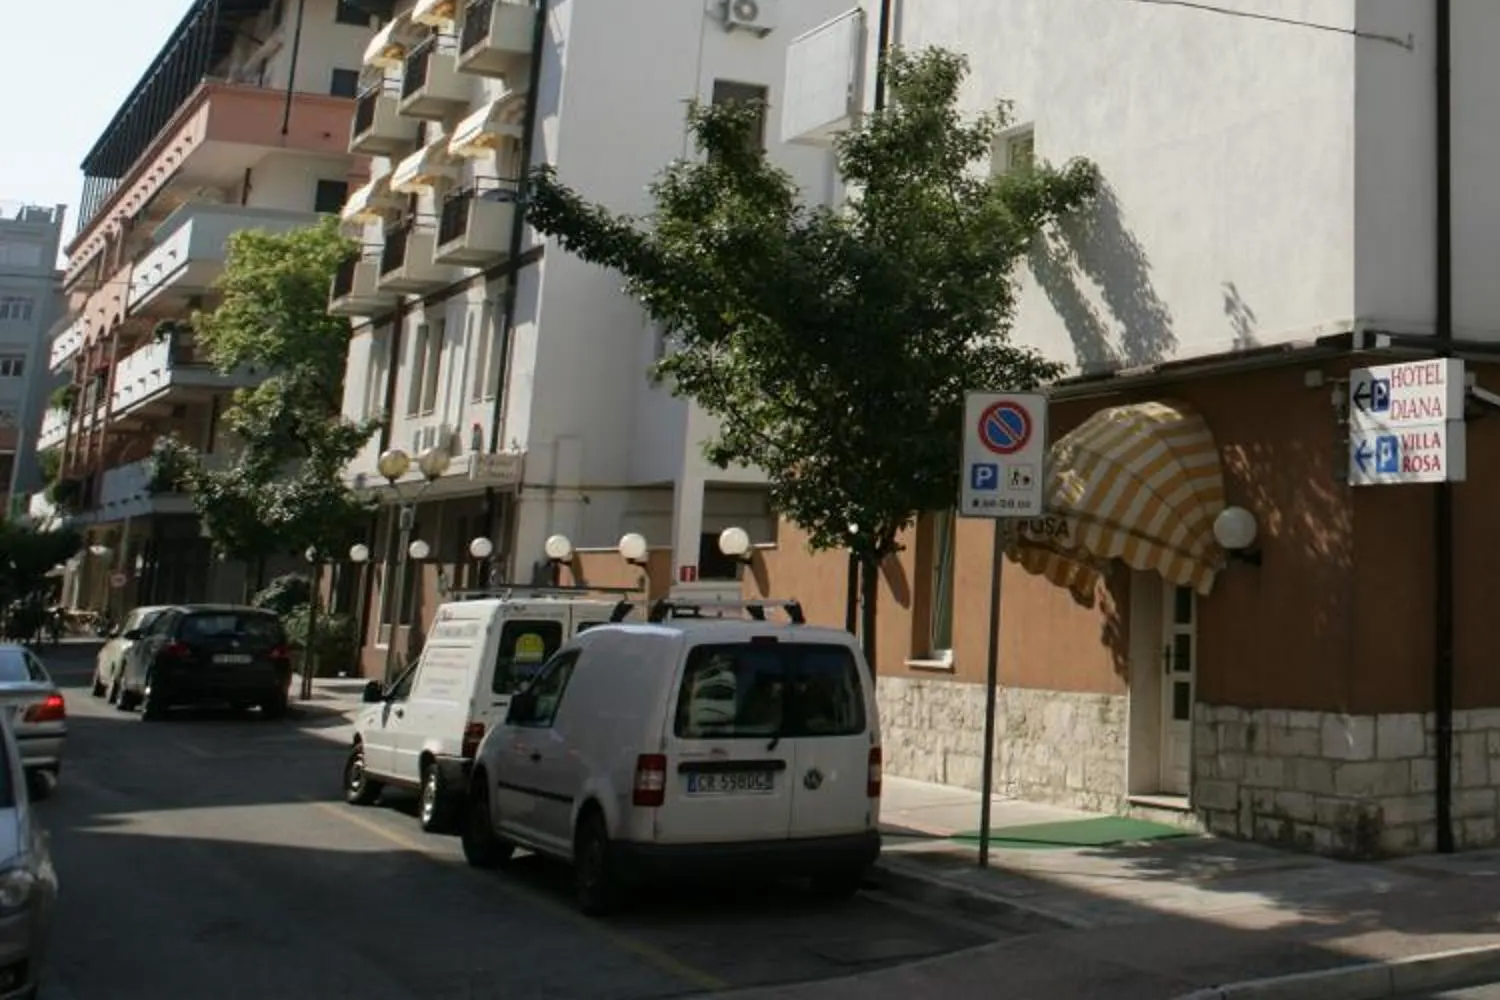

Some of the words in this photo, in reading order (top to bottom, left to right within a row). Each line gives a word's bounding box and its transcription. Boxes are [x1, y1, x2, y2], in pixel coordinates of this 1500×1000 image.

[1391, 364, 1443, 388] HOTEL
[1391, 396, 1442, 421] DIANA
[1401, 432, 1441, 451] VILLA
[1402, 455, 1441, 473] ROSA
